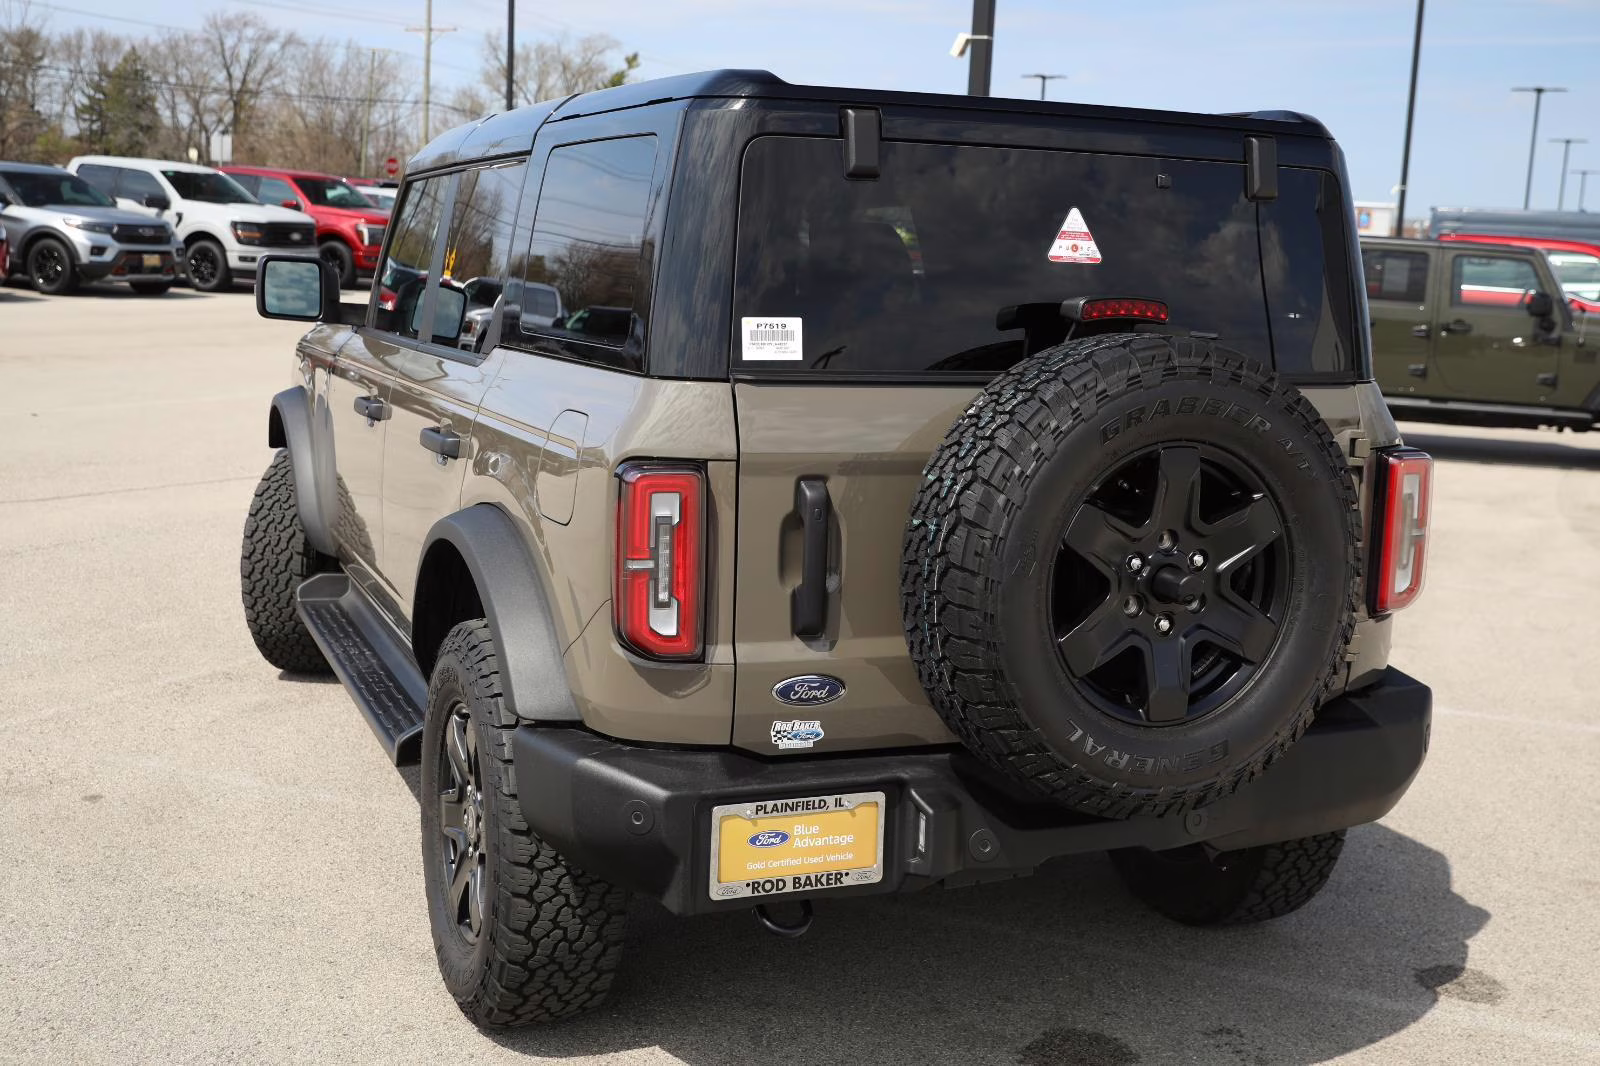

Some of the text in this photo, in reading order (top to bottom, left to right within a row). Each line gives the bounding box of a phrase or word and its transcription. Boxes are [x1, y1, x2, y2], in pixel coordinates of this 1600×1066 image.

[1100, 396, 1272, 446] GRABBER
[790, 682, 829, 700] Ford
[1065, 718, 1229, 776] GENERAL
[755, 797, 844, 815] PLAINFIELD, IL
[793, 824, 820, 836] Blue
[793, 833, 854, 849] Advantage
[746, 851, 853, 870] Gold Certified Used Vehicle
[751, 872, 844, 895] ROD BAKER
